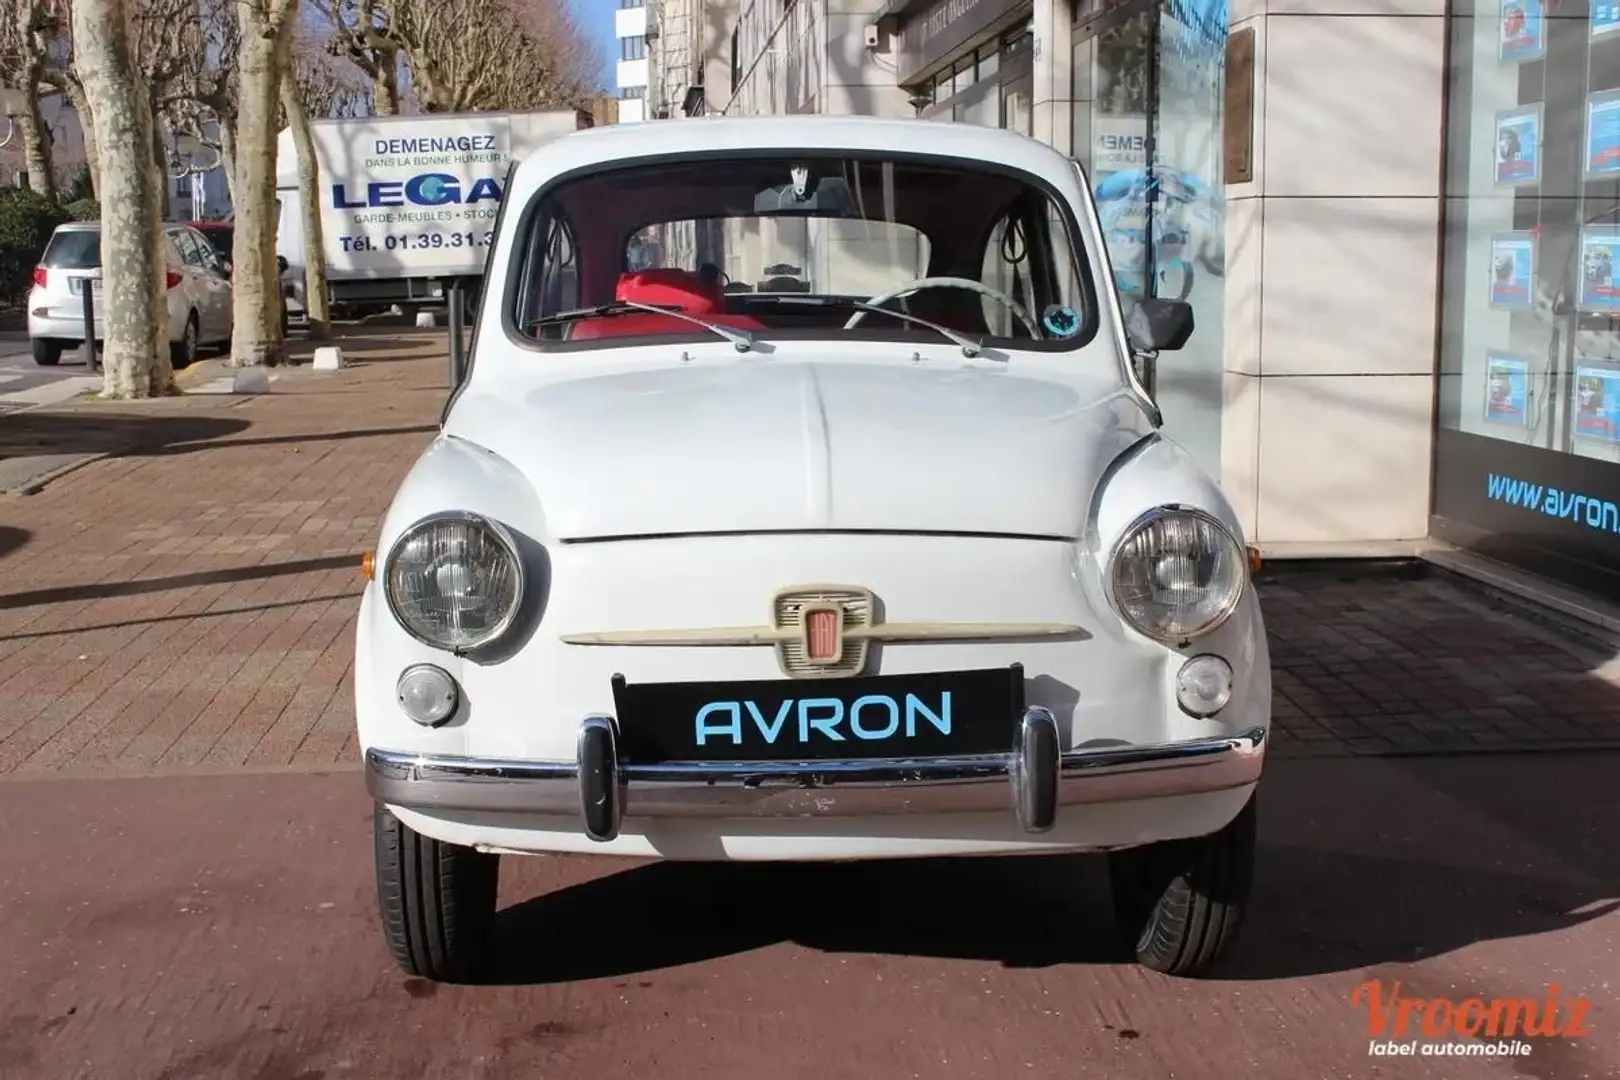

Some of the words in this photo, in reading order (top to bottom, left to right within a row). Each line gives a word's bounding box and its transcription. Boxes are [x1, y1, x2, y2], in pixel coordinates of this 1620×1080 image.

[376, 135, 496, 154] DEMENAGEZ
[365, 157, 394, 168] DANS
[397, 156, 411, 167] LA
[414, 155, 451, 165] BONNE
[454, 153, 503, 164] HUMEUR
[332, 173, 506, 209] LEGA
[354, 210, 452, 224] GARDE-MEUBLES
[464, 208, 498, 220] STOC
[339, 235, 377, 252] Tél.
[695, 691, 952, 745] AVRON
